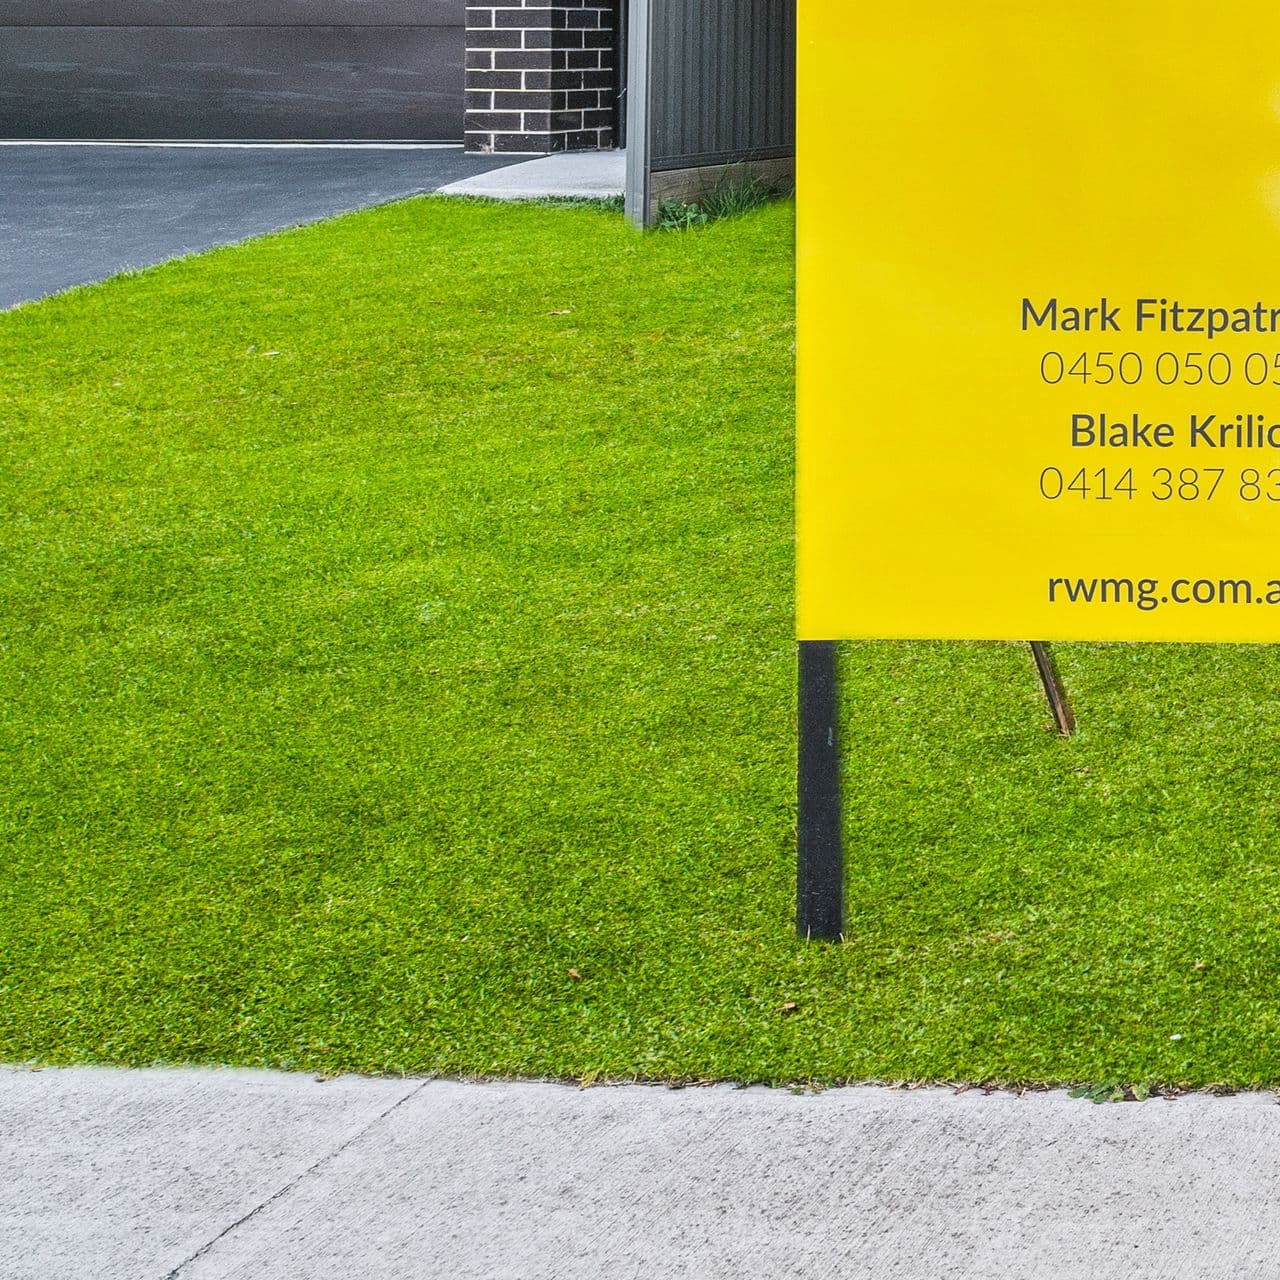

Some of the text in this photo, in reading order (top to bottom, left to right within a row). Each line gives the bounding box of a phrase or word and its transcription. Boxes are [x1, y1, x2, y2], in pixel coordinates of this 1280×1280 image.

[1021, 297, 1121, 332] Mark
[1040, 351, 1143, 385] 0450
[1155, 351, 1232, 386] 050
[1071, 413, 1175, 448] Blake
[1039, 466, 1138, 501] 0414
[1151, 467, 1225, 501] 387
